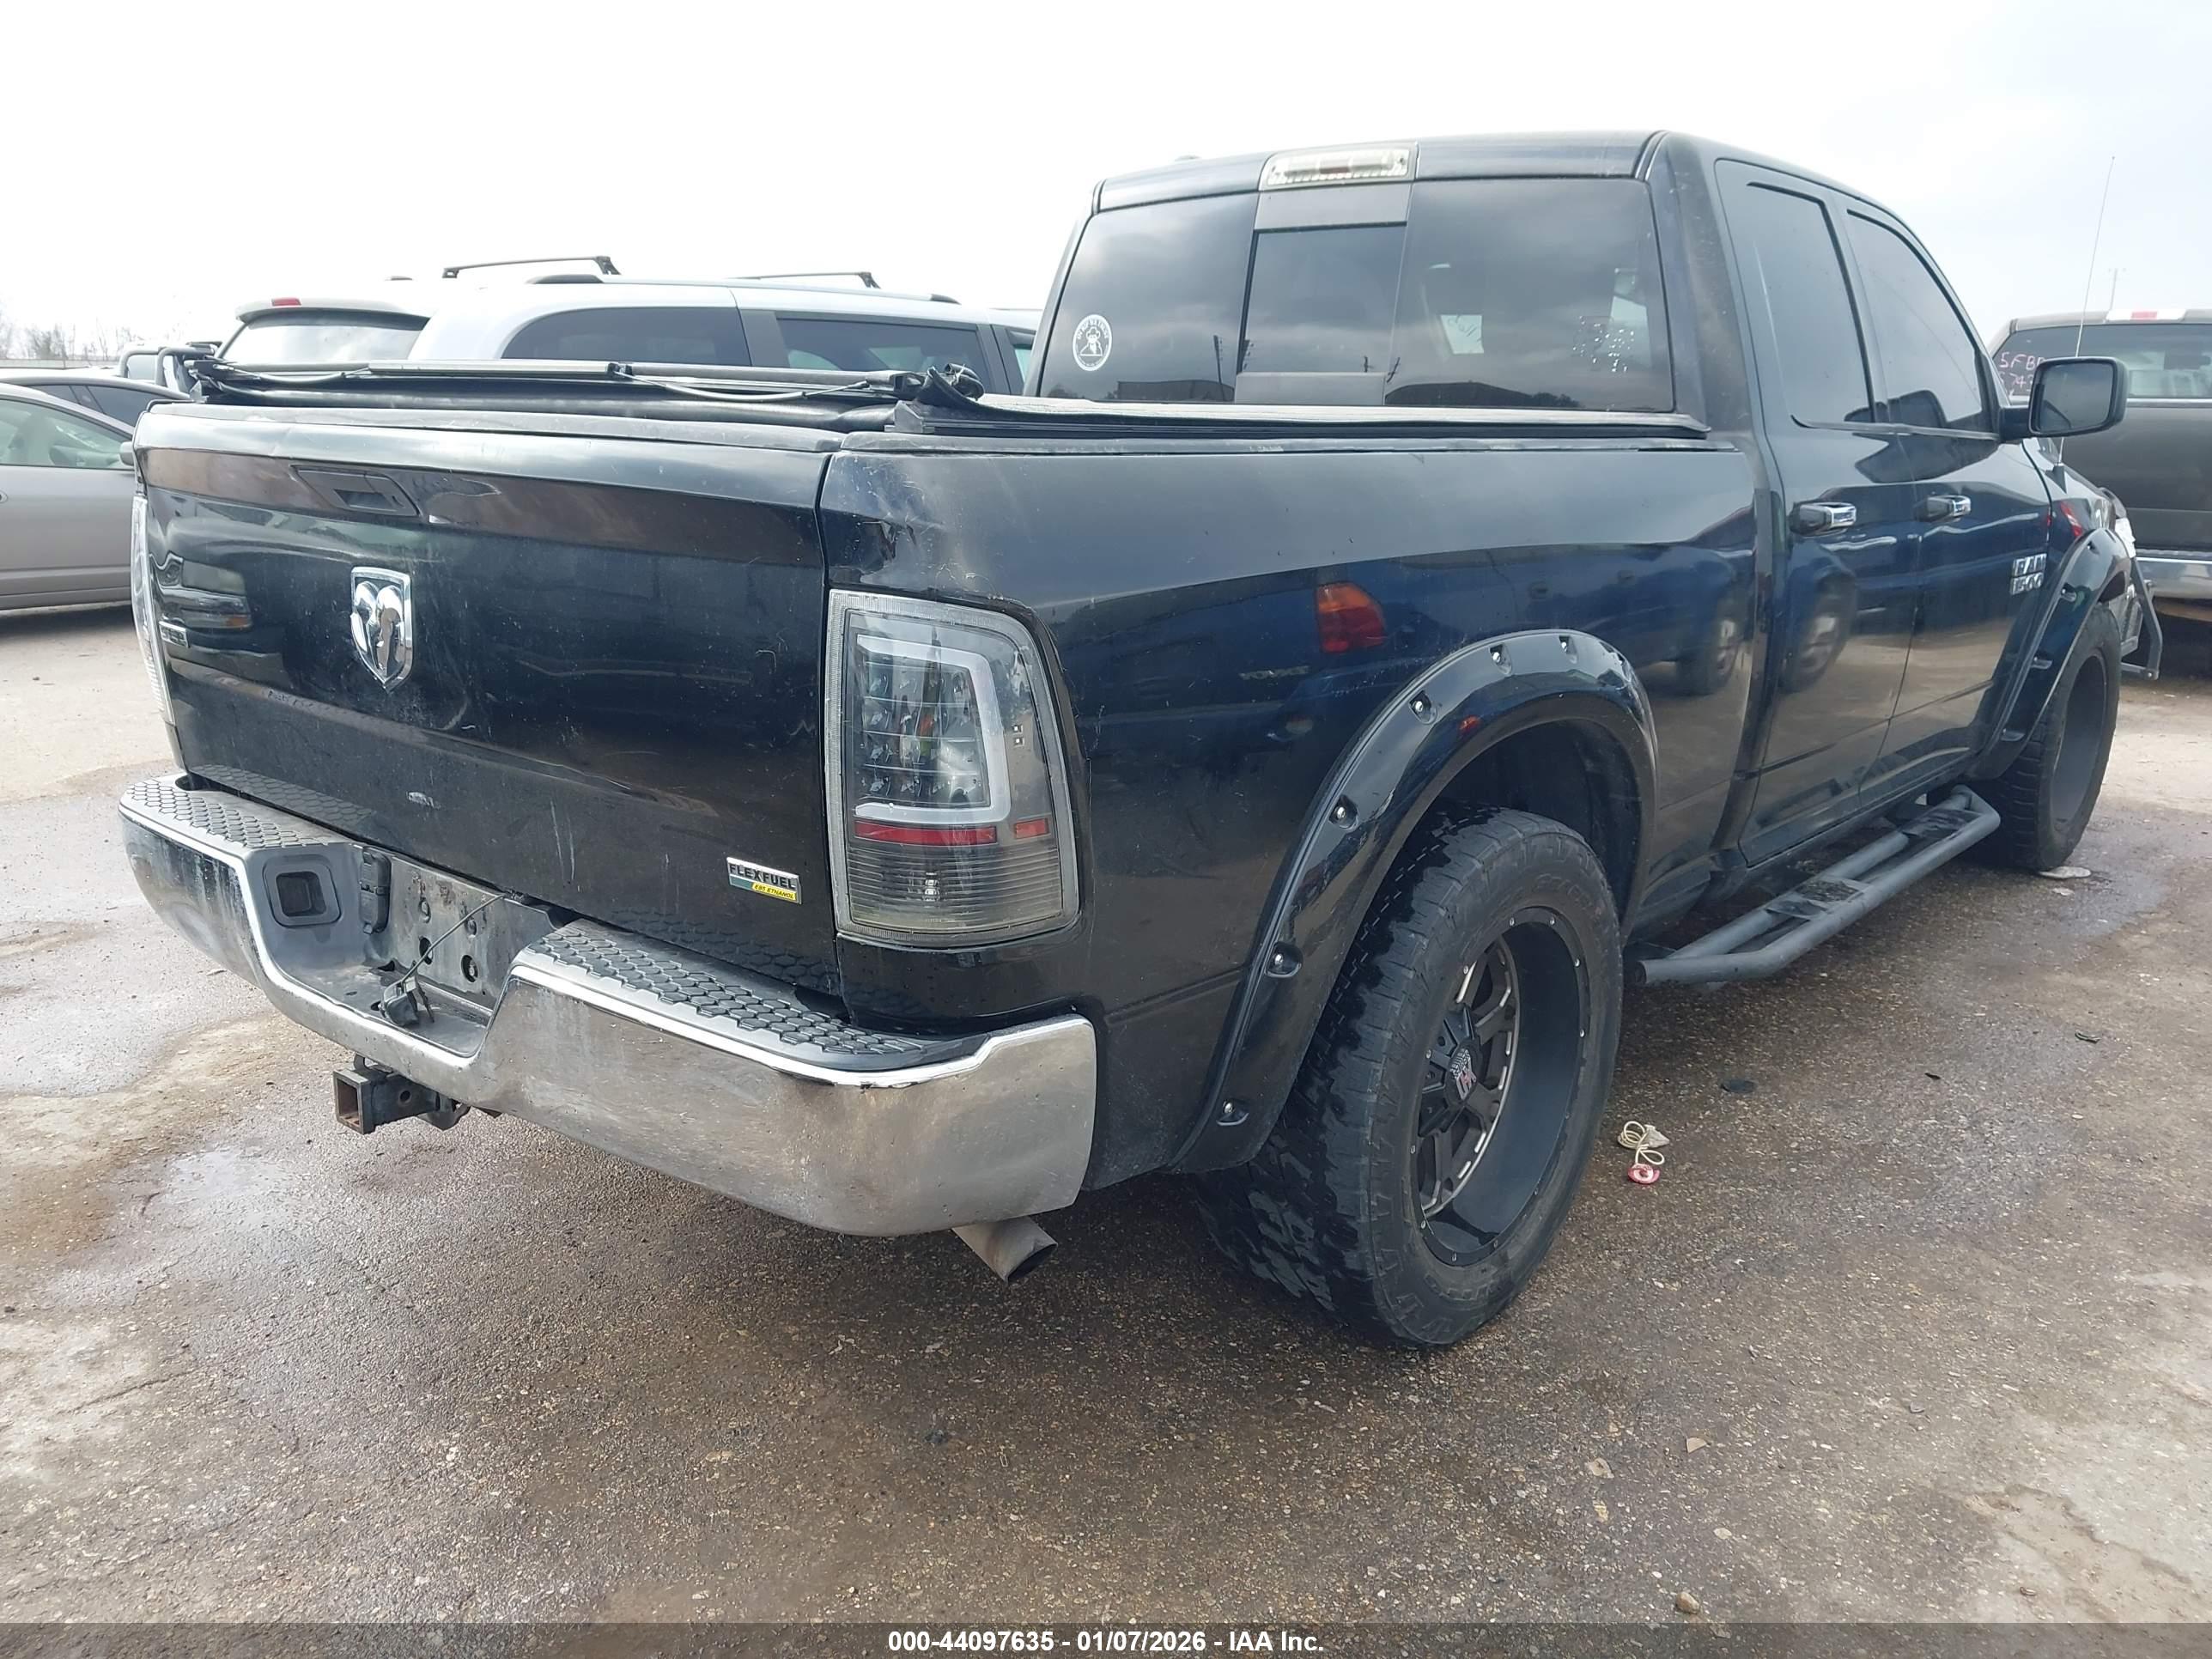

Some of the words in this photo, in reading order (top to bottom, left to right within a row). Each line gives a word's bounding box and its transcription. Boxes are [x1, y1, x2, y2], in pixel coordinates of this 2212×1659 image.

[2013, 553, 2047, 576] RAM
[2010, 572, 2045, 595] 1500
[729, 863, 797, 890] FLEXFUEL
